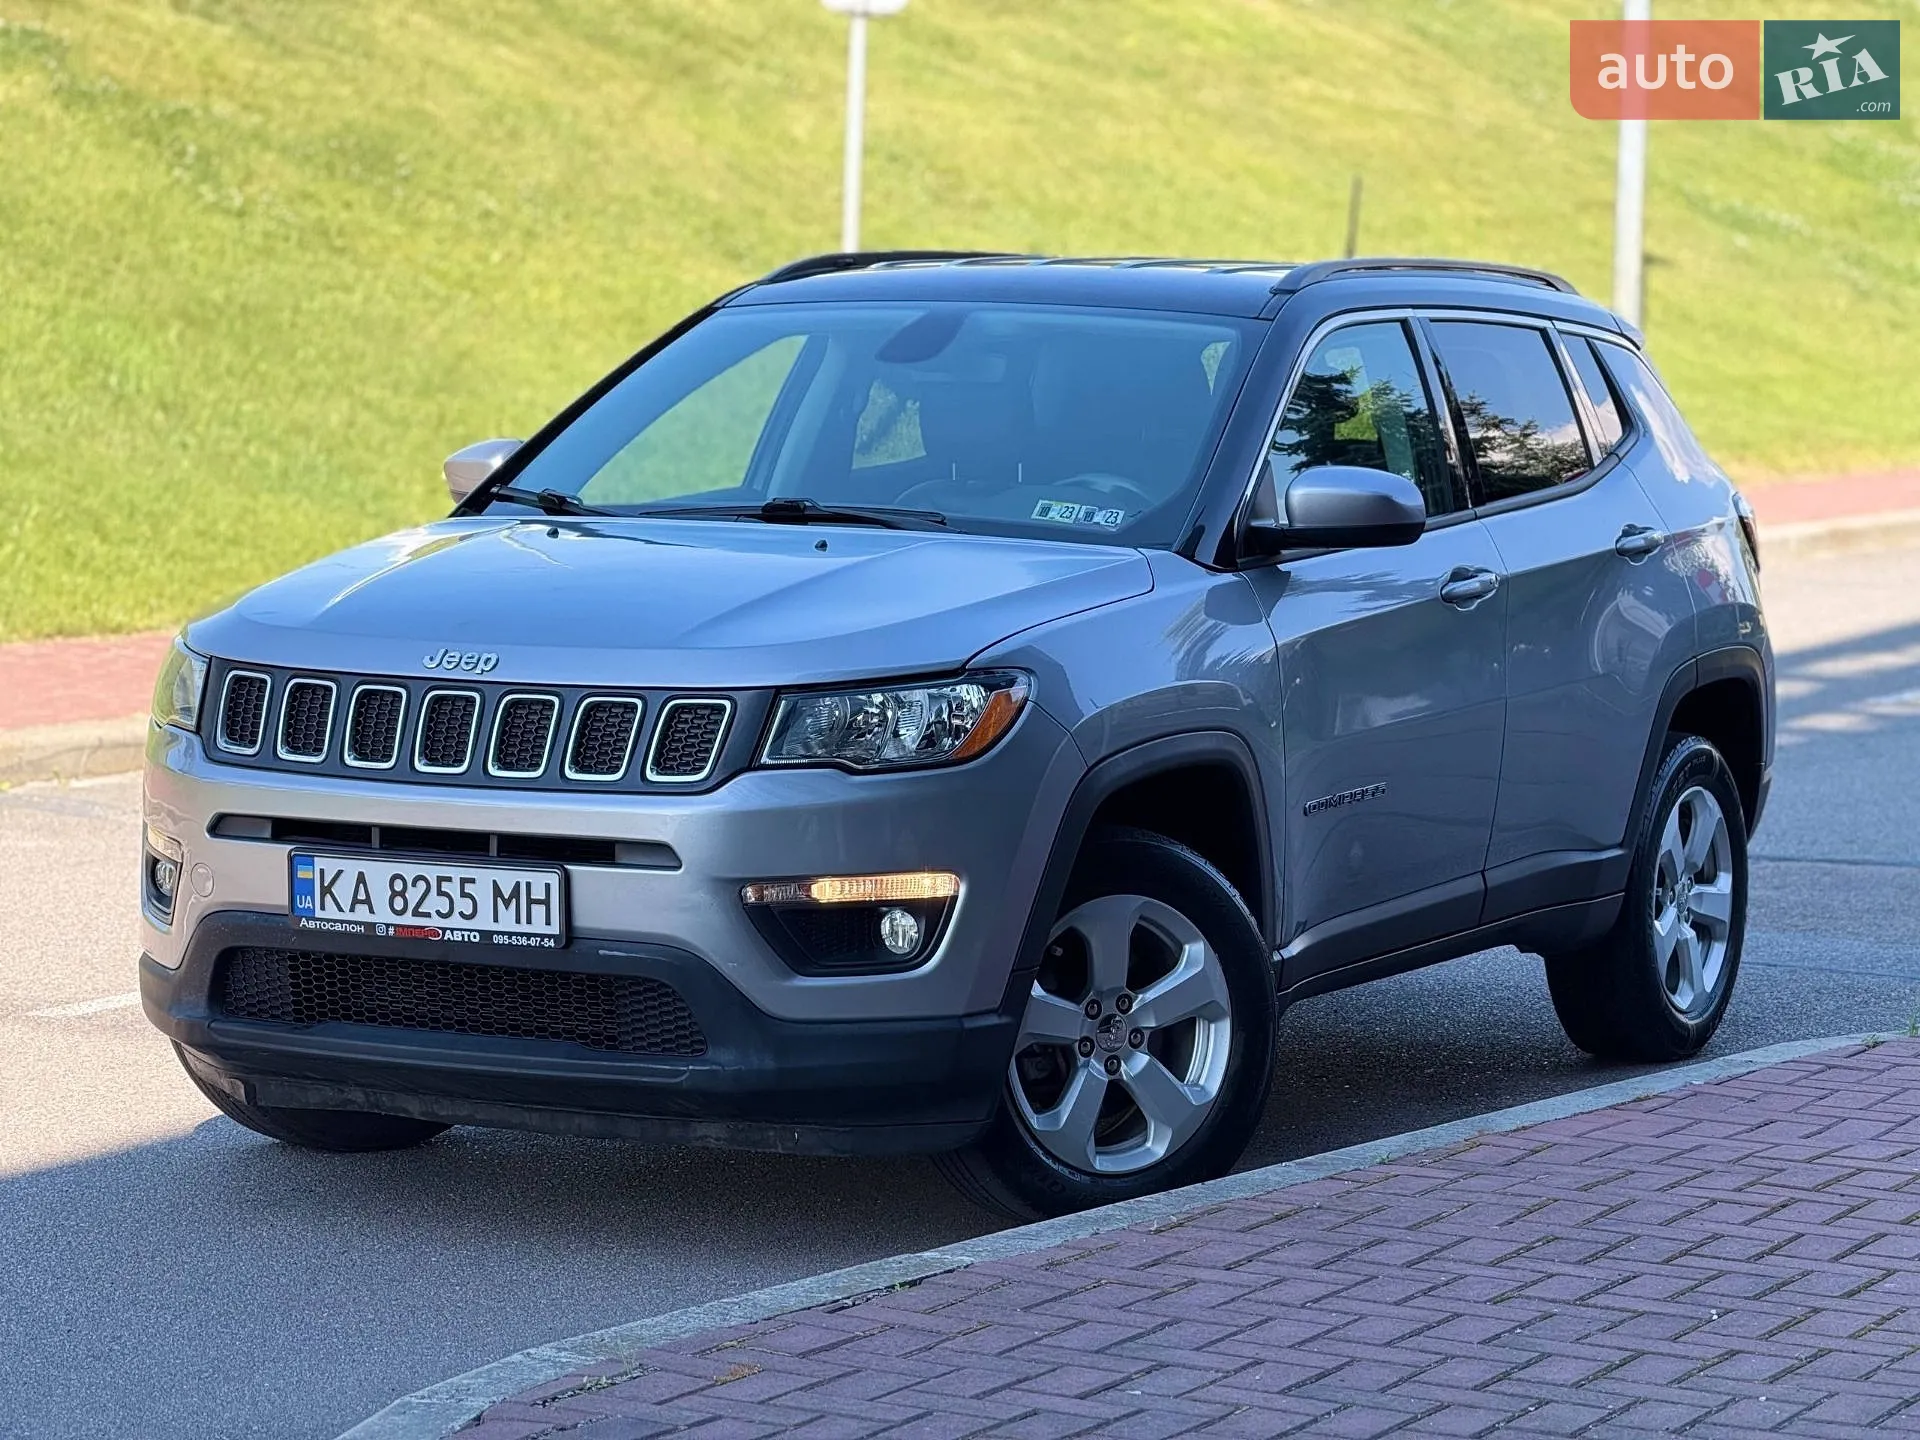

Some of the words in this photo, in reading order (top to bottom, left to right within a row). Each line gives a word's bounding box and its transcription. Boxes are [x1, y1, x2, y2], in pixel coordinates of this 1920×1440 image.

[422, 647, 499, 674] Jeep
[296, 895, 313, 910] UA
[318, 867, 376, 915] KA
[388, 872, 479, 921] 8255
[492, 879, 551, 926] MH
[299, 917, 365, 933] Автосалон
[492, 934, 555, 948] 095-536-07-54
